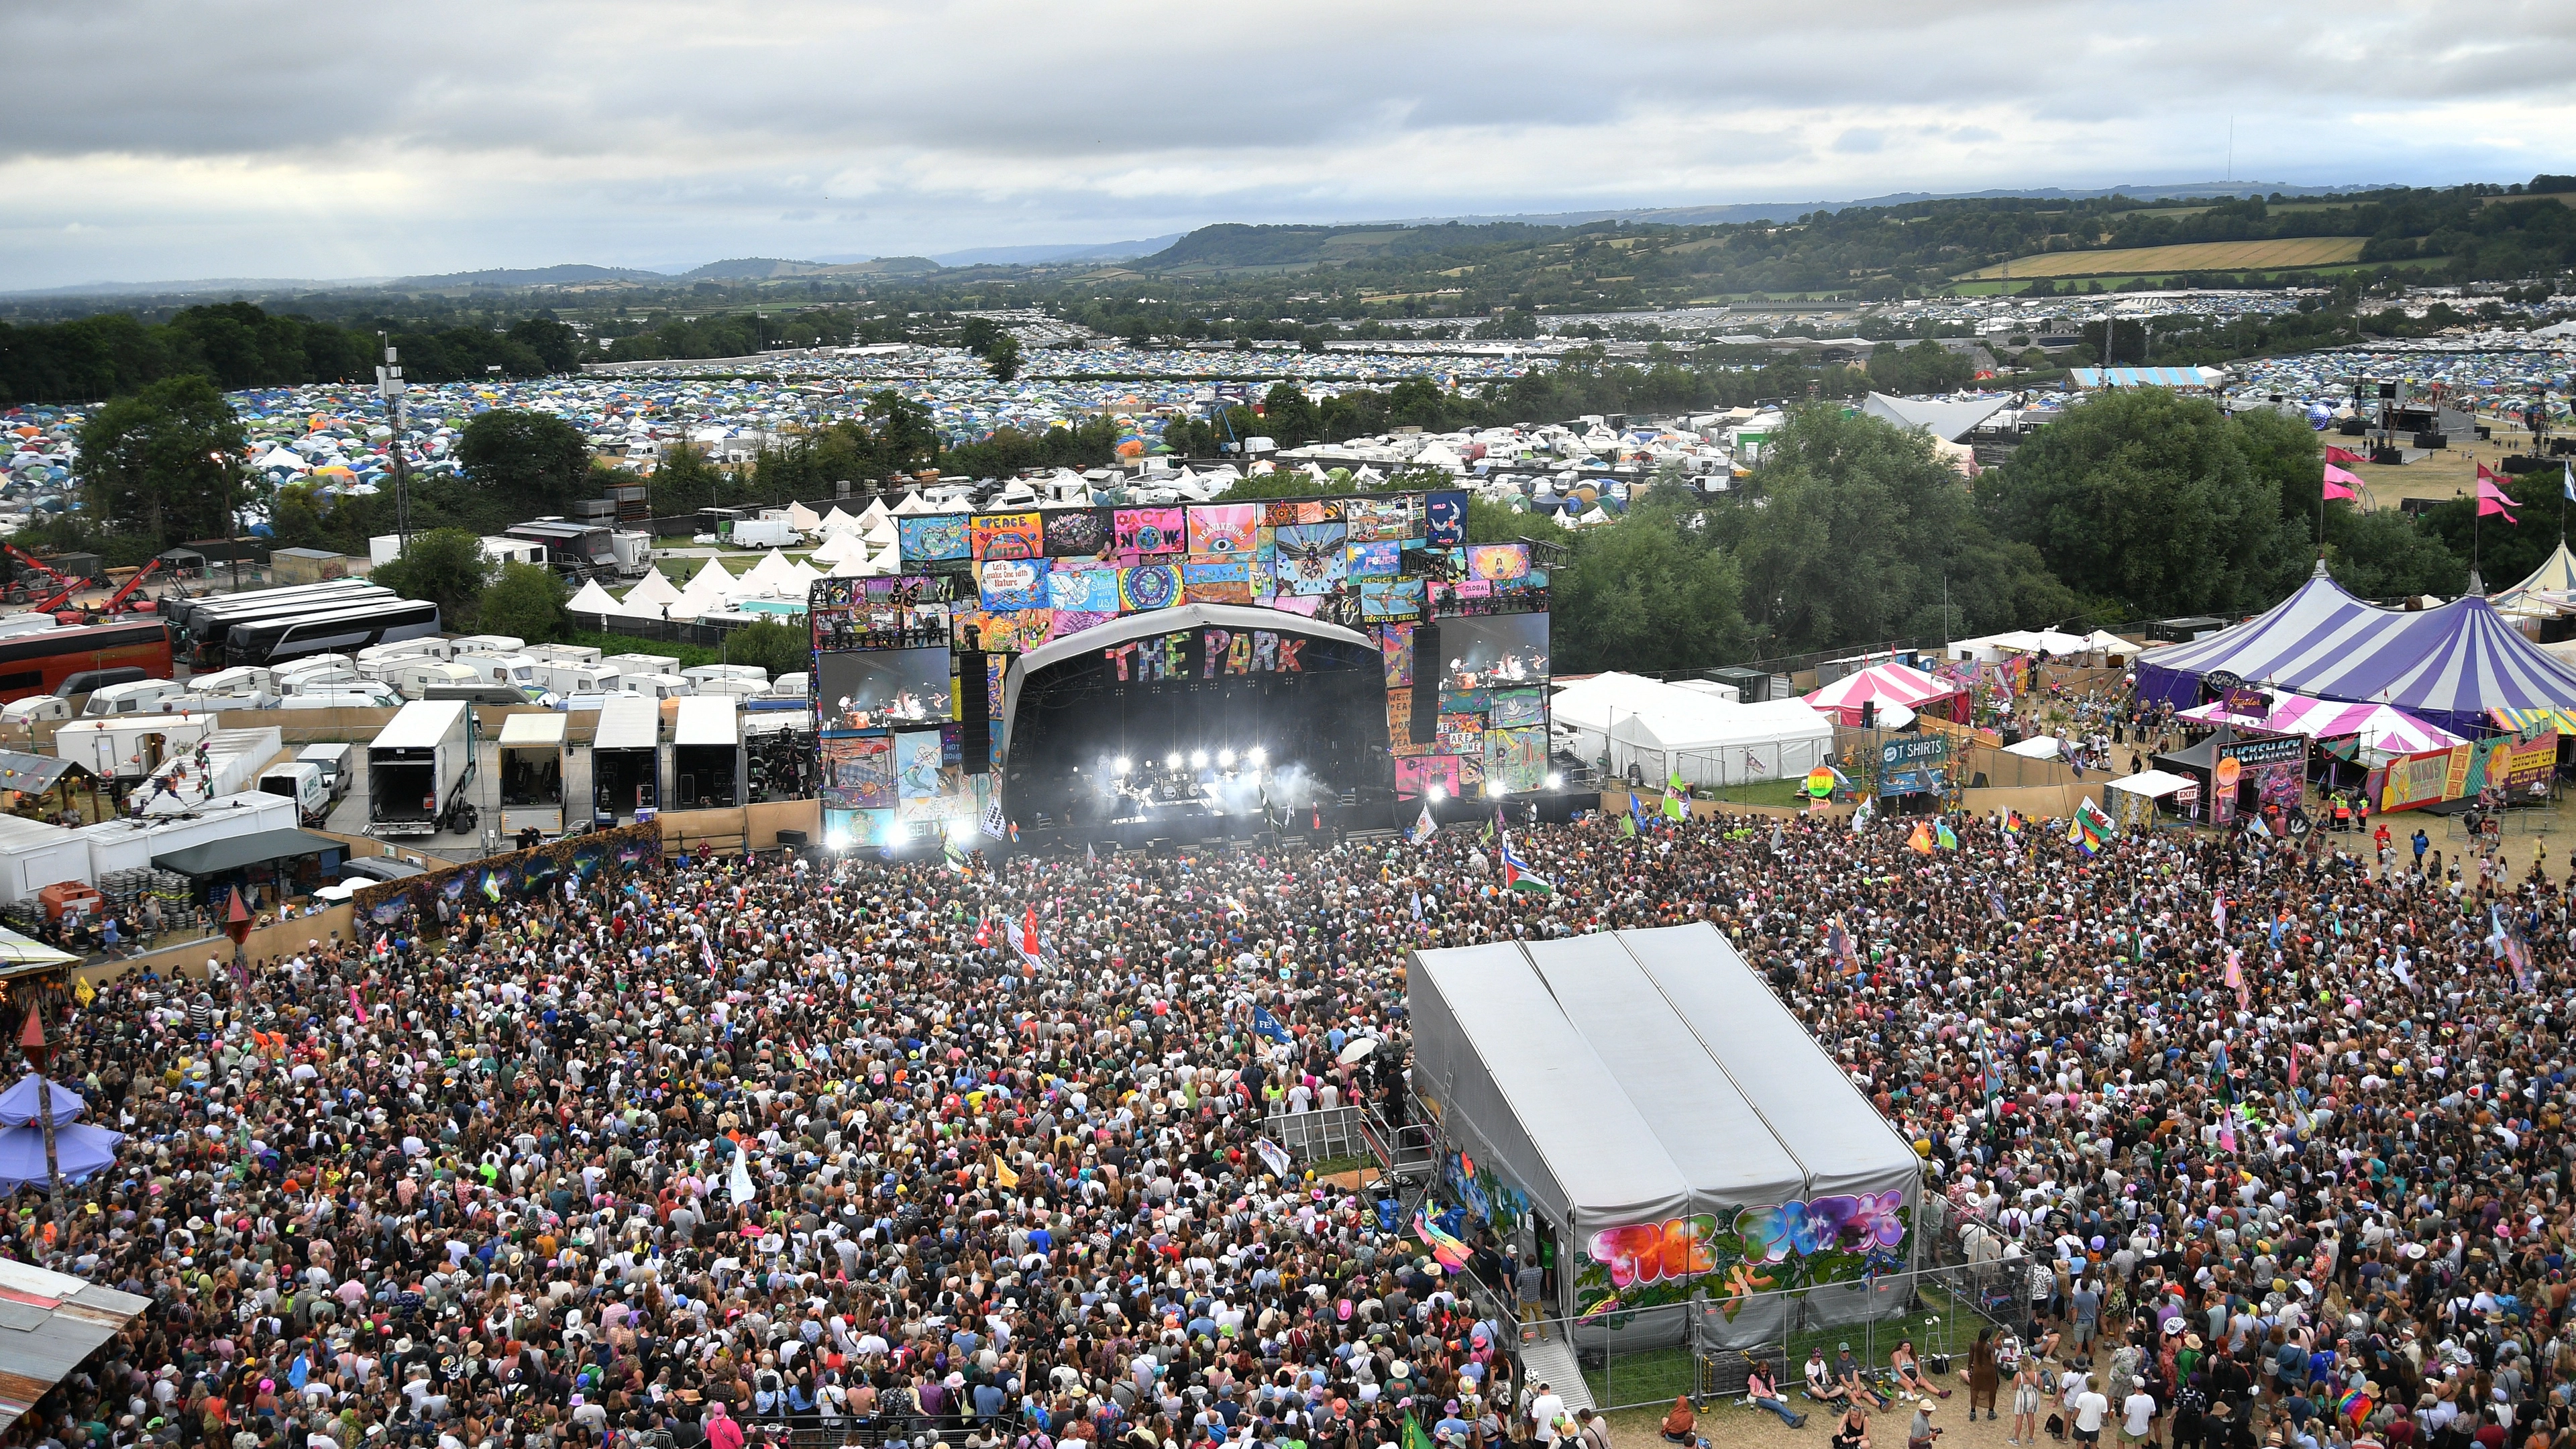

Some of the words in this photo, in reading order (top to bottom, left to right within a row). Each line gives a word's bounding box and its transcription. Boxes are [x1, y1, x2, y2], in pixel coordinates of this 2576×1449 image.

[906, 518, 930, 527] STAY
[985, 516, 1027, 529] PEACE
[1128, 511, 1167, 524] ACT
[1197, 522, 1248, 542] REAWAKENING
[986, 546, 1024, 558] UNITY
[992, 562, 1007, 571] Let's
[994, 579, 1018, 588] Nature
[1091, 581, 1116, 592] Starts
[1148, 597, 1161, 605] make
[1106, 631, 1193, 682] THE
[1203, 629, 1307, 680] PARK
[1389, 693, 1401, 702] WE
[1451, 733, 1470, 743] ARE
[1462, 743, 1479, 751] ONE
[1897, 745, 1904, 759] T
[1907, 740, 1941, 757] SHIRTS
[2222, 739, 2302, 763] FLICKSHACK
[2512, 753, 2540, 768] SHOW
[2541, 750, 2555, 762] UP
[2510, 768, 2538, 785] GLOW
[2179, 790, 2196, 798] EXIT
[988, 806, 999, 824] FREE
[907, 822, 928, 837] GET
[1589, 1213, 1718, 1288] THE
[1733, 1187, 1904, 1265] PARK
